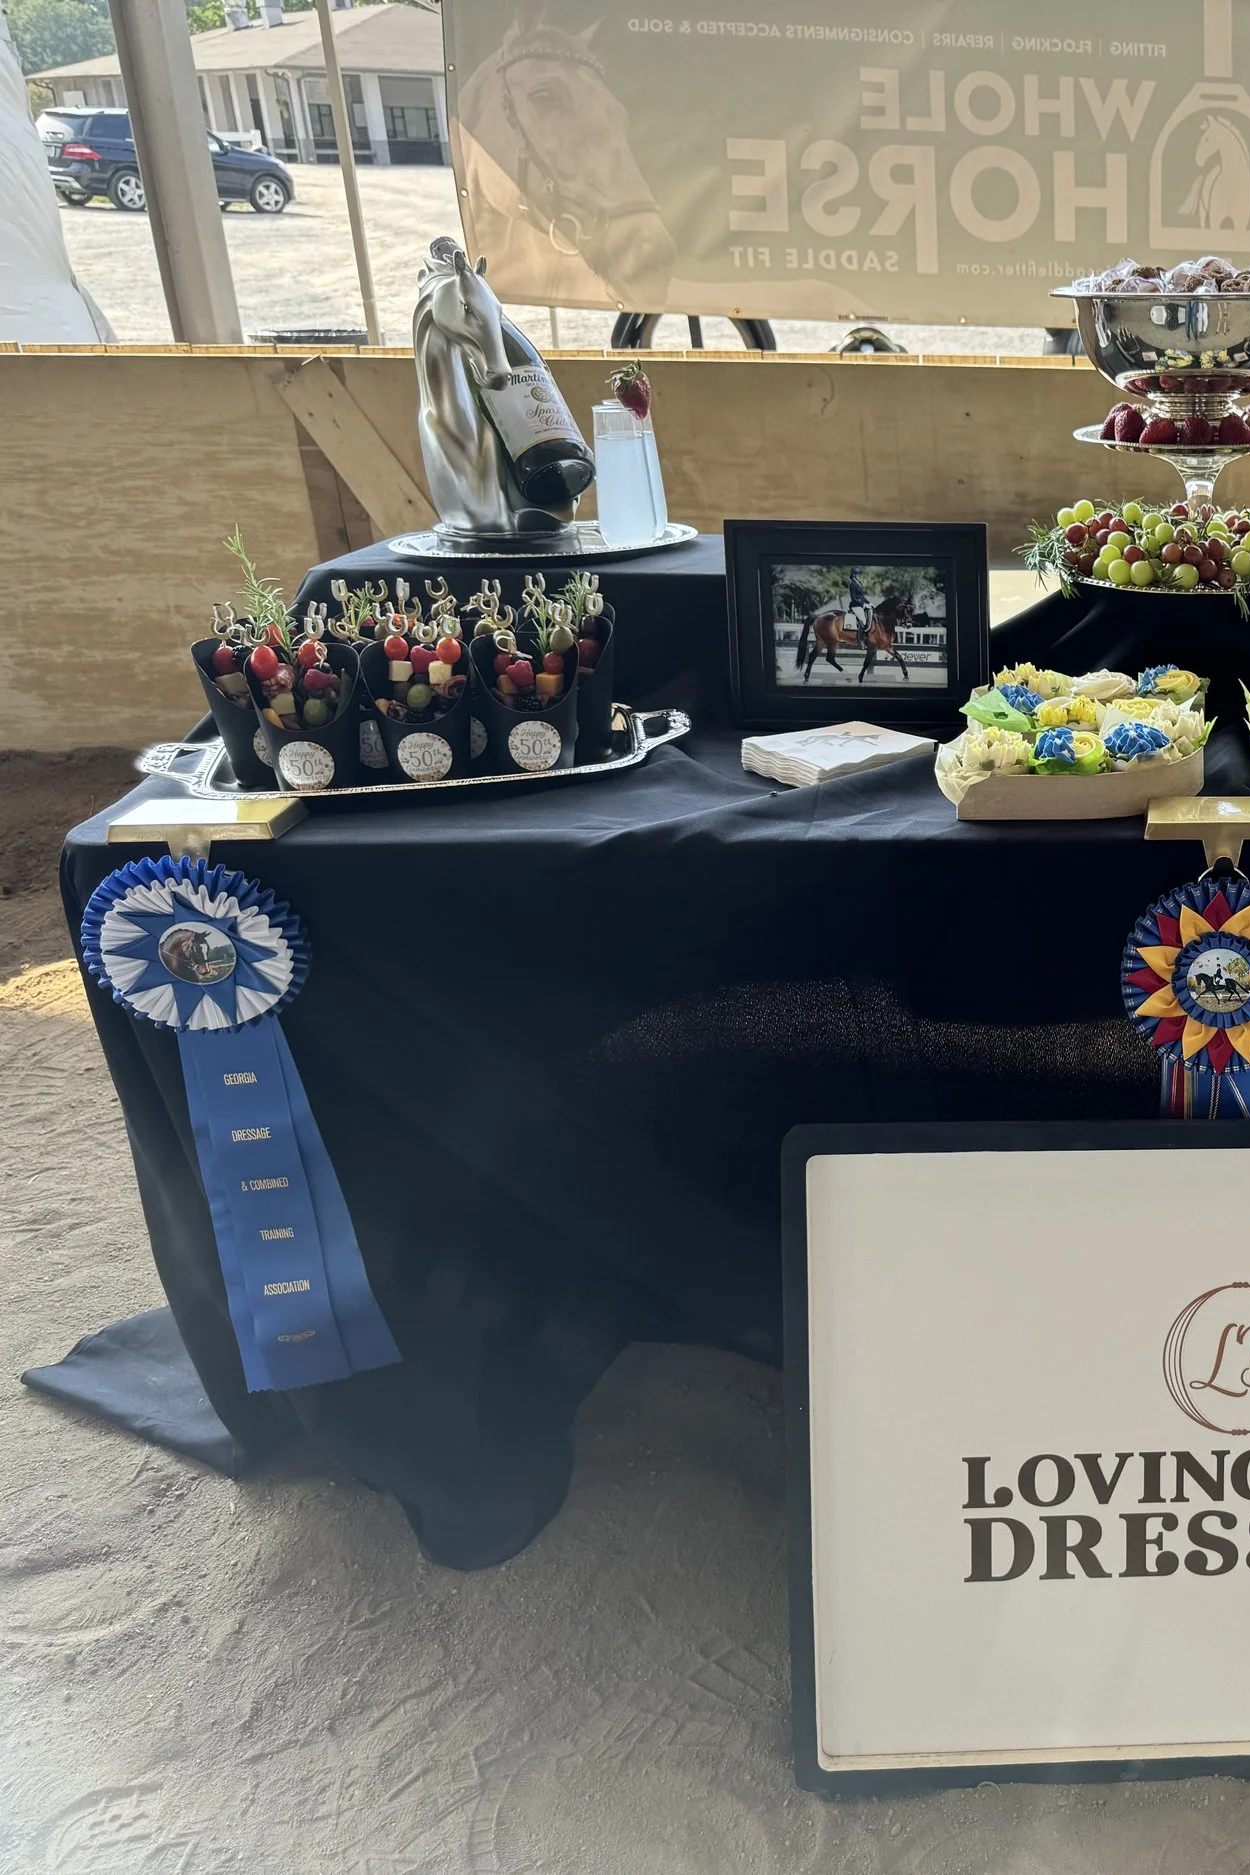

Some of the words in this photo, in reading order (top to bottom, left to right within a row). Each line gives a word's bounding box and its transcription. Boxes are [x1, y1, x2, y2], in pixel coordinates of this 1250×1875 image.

[223, 1072, 257, 1085] GEORGIA
[232, 1127, 271, 1142] DRESSAGE
[249, 1177, 289, 1191] COMBINED
[260, 1227, 294, 1240] TRAINING
[264, 1280, 310, 1295] ASSOCIATION
